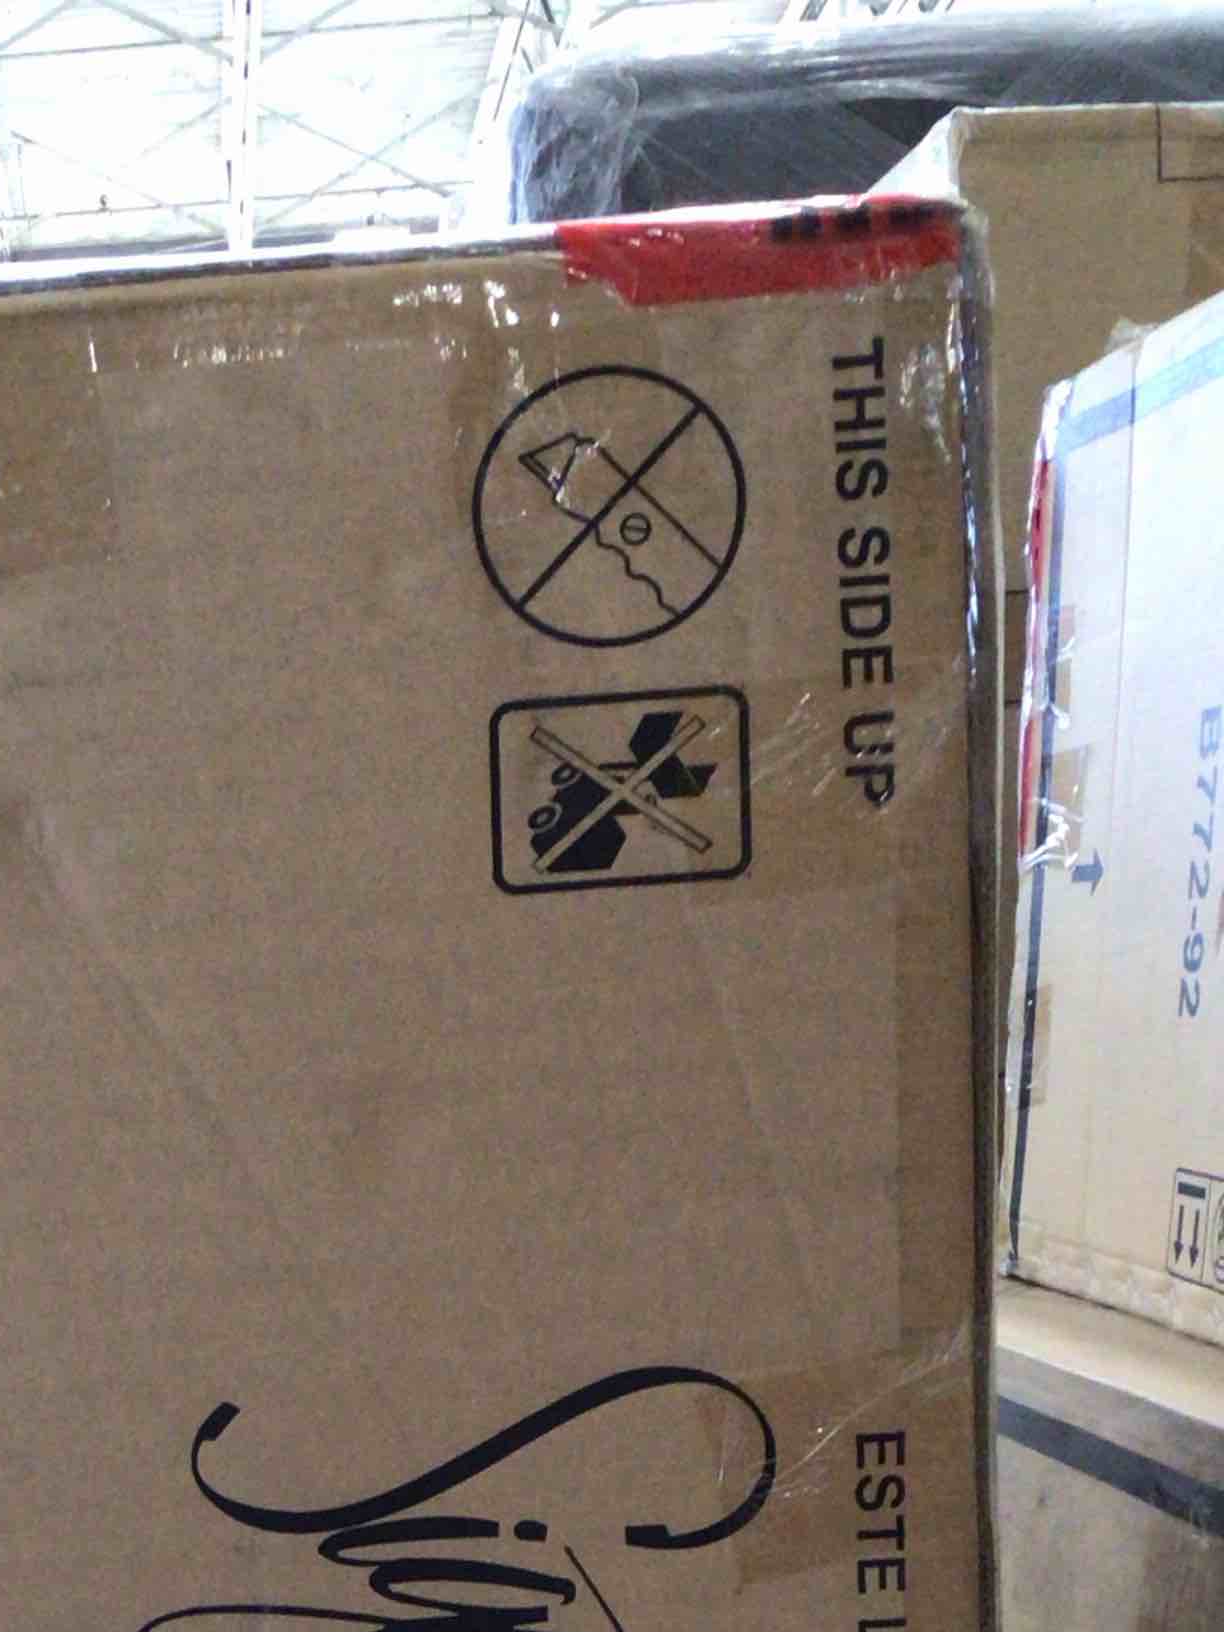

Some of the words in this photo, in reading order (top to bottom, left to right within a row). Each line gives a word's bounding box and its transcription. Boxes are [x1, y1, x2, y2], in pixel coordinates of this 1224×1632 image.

[831, 338, 890, 504] THIS
[837, 527, 894, 689] SIDE
[841, 711, 895, 812] UP
[1178, 704, 1223, 1020] B772-92
[854, 1428, 907, 1595] ESTE
